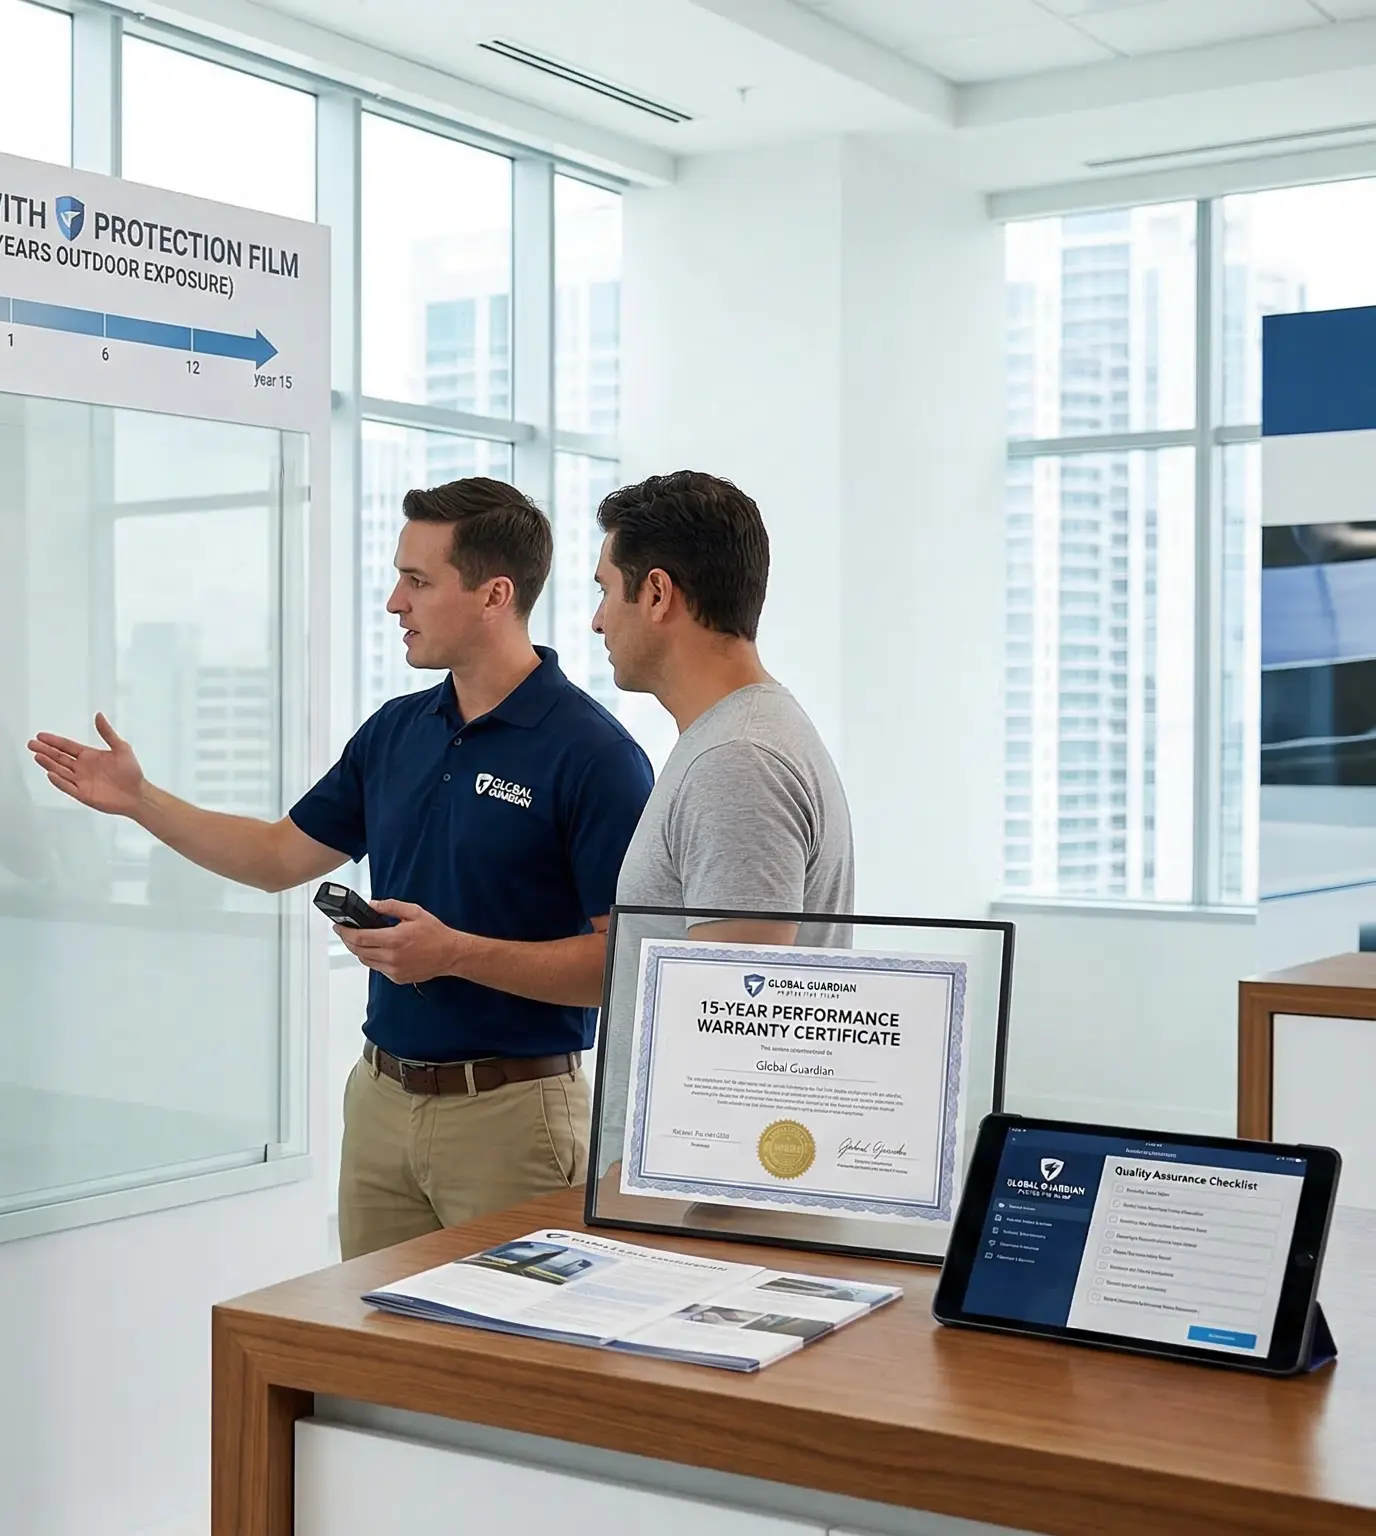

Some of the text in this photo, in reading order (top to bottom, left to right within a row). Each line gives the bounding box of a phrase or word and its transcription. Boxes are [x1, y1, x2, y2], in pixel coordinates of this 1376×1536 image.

[94, 211, 243, 268] PROTECTION
[249, 243, 299, 280] FILM
[56, 244, 140, 280] OUTDOOR
[143, 261, 235, 301] EXPOSURE)
[7, 332, 14, 347] 1
[101, 346, 110, 362] 6
[185, 359, 201, 375] 12
[253, 372, 293, 390] year 15
[767, 978, 857, 993] GLOBAL GUARDIAN
[700, 1000, 900, 1028] 15-YEAR PERFORMANCE
[697, 1018, 902, 1047] WARRANTY CERTIFICATE
[789, 1062, 835, 1076] Guardian
[1114, 1165, 1259, 1191] Quality Assurance Checklist
